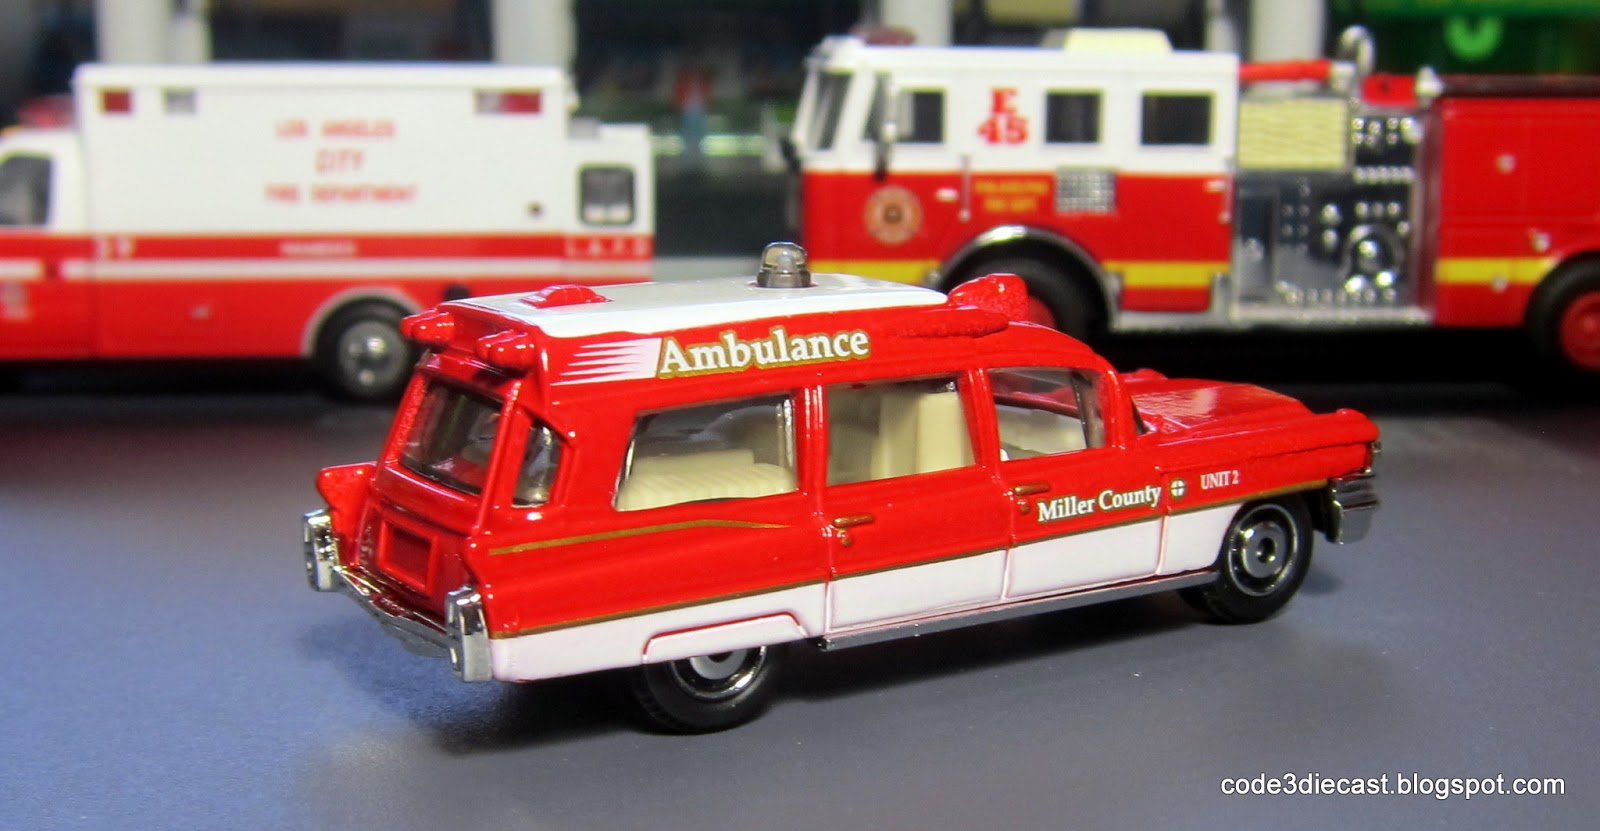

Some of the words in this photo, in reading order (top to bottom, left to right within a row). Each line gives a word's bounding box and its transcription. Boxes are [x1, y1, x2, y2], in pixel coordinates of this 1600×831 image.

[991, 87, 1019, 114] E
[977, 116, 1029, 144] 45
[315, 149, 364, 174] CITY
[658, 327, 870, 377] Ambulance
[1200, 471, 1231, 490] UNIT
[1231, 469, 1240, 485] 2
[1037, 495, 1096, 522] Miller
[1099, 485, 1162, 511] County
